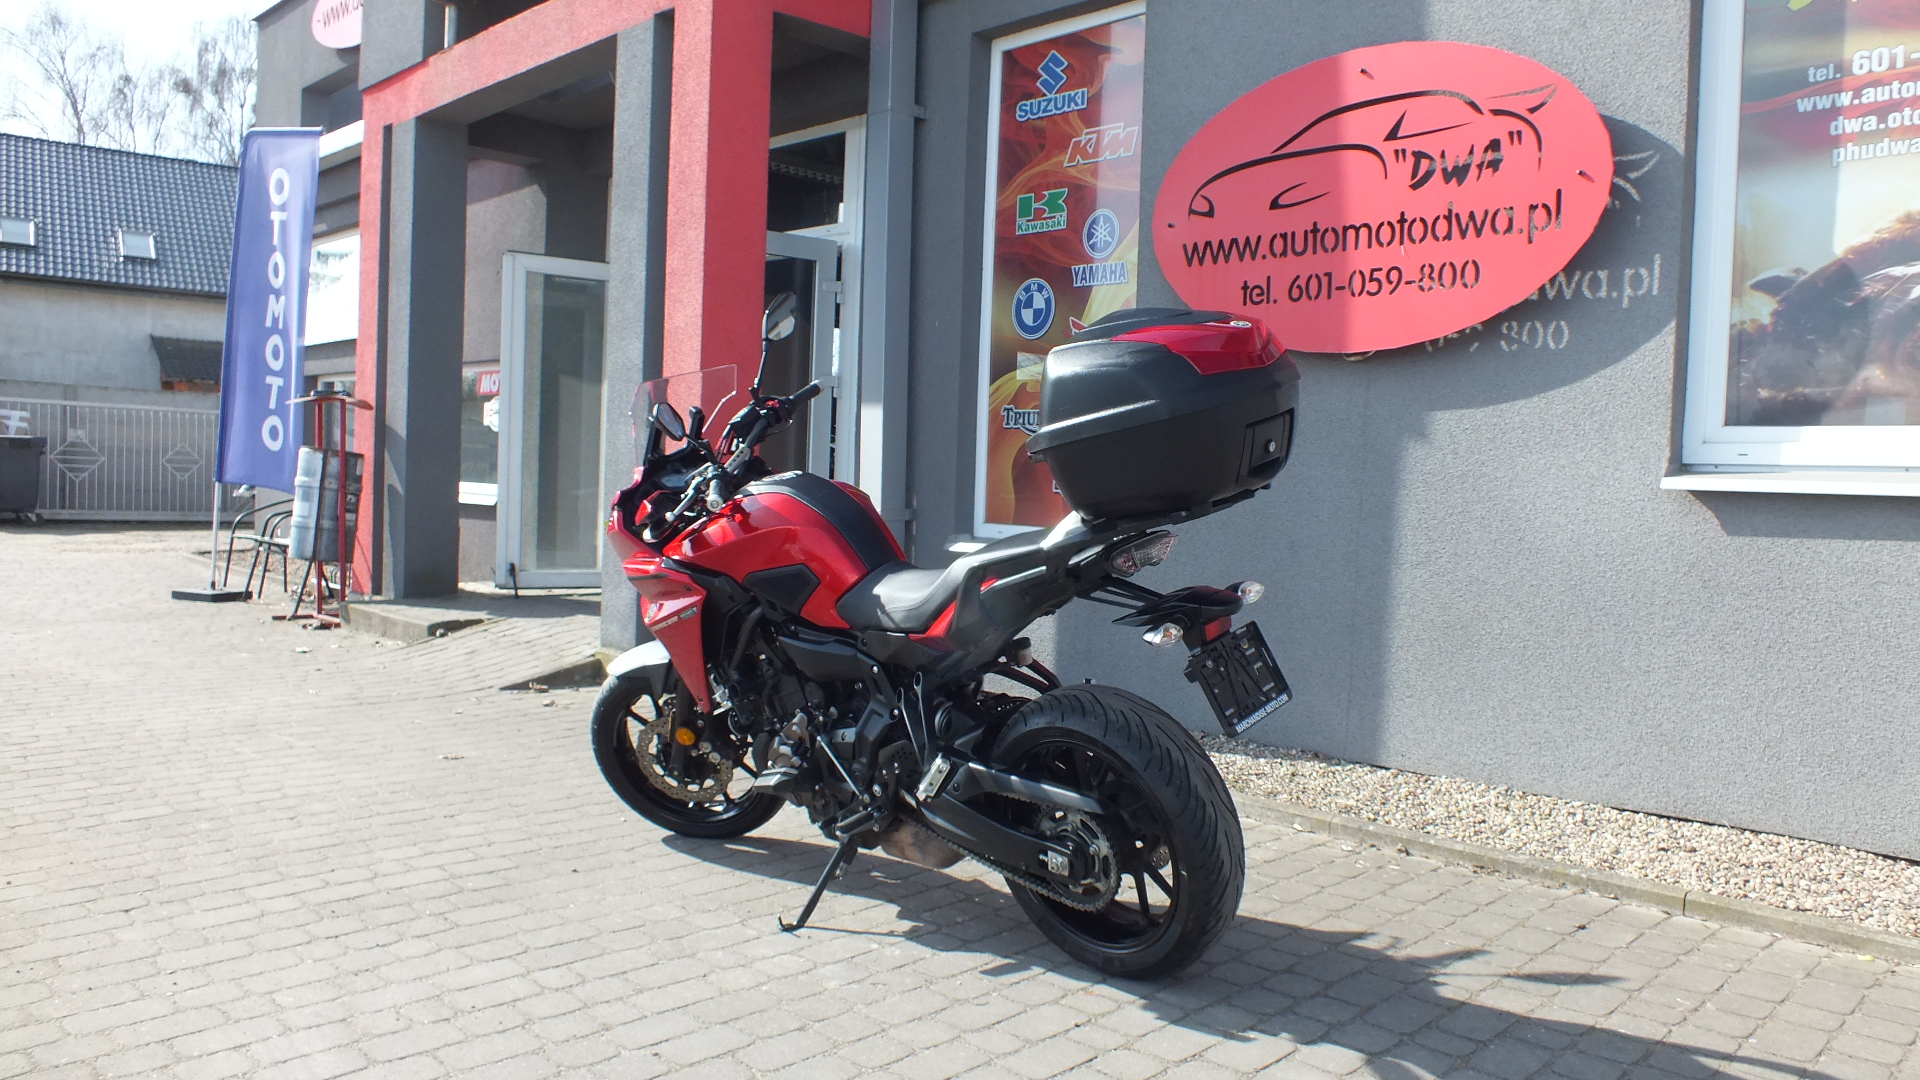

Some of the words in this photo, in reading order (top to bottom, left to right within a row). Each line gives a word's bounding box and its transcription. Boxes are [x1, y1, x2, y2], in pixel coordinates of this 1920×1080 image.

[1808, 63, 1841, 82] tel.
[1016, 88, 1088, 121] SUZUKI
[1796, 80, 1920, 113] www.auto
[1064, 123, 1138, 167] KTM
[1017, 215, 1067, 234] Kawasaki
[1182, 188, 1563, 268] www.automotodwa.pl
[1072, 261, 1128, 287] YAMAHA
[1240, 275, 1278, 307] tel.
[1288, 259, 1481, 302] 601-059-800
[261, 167, 290, 452] OTOMOTO
[1001, 405, 1040, 430] TRIU
